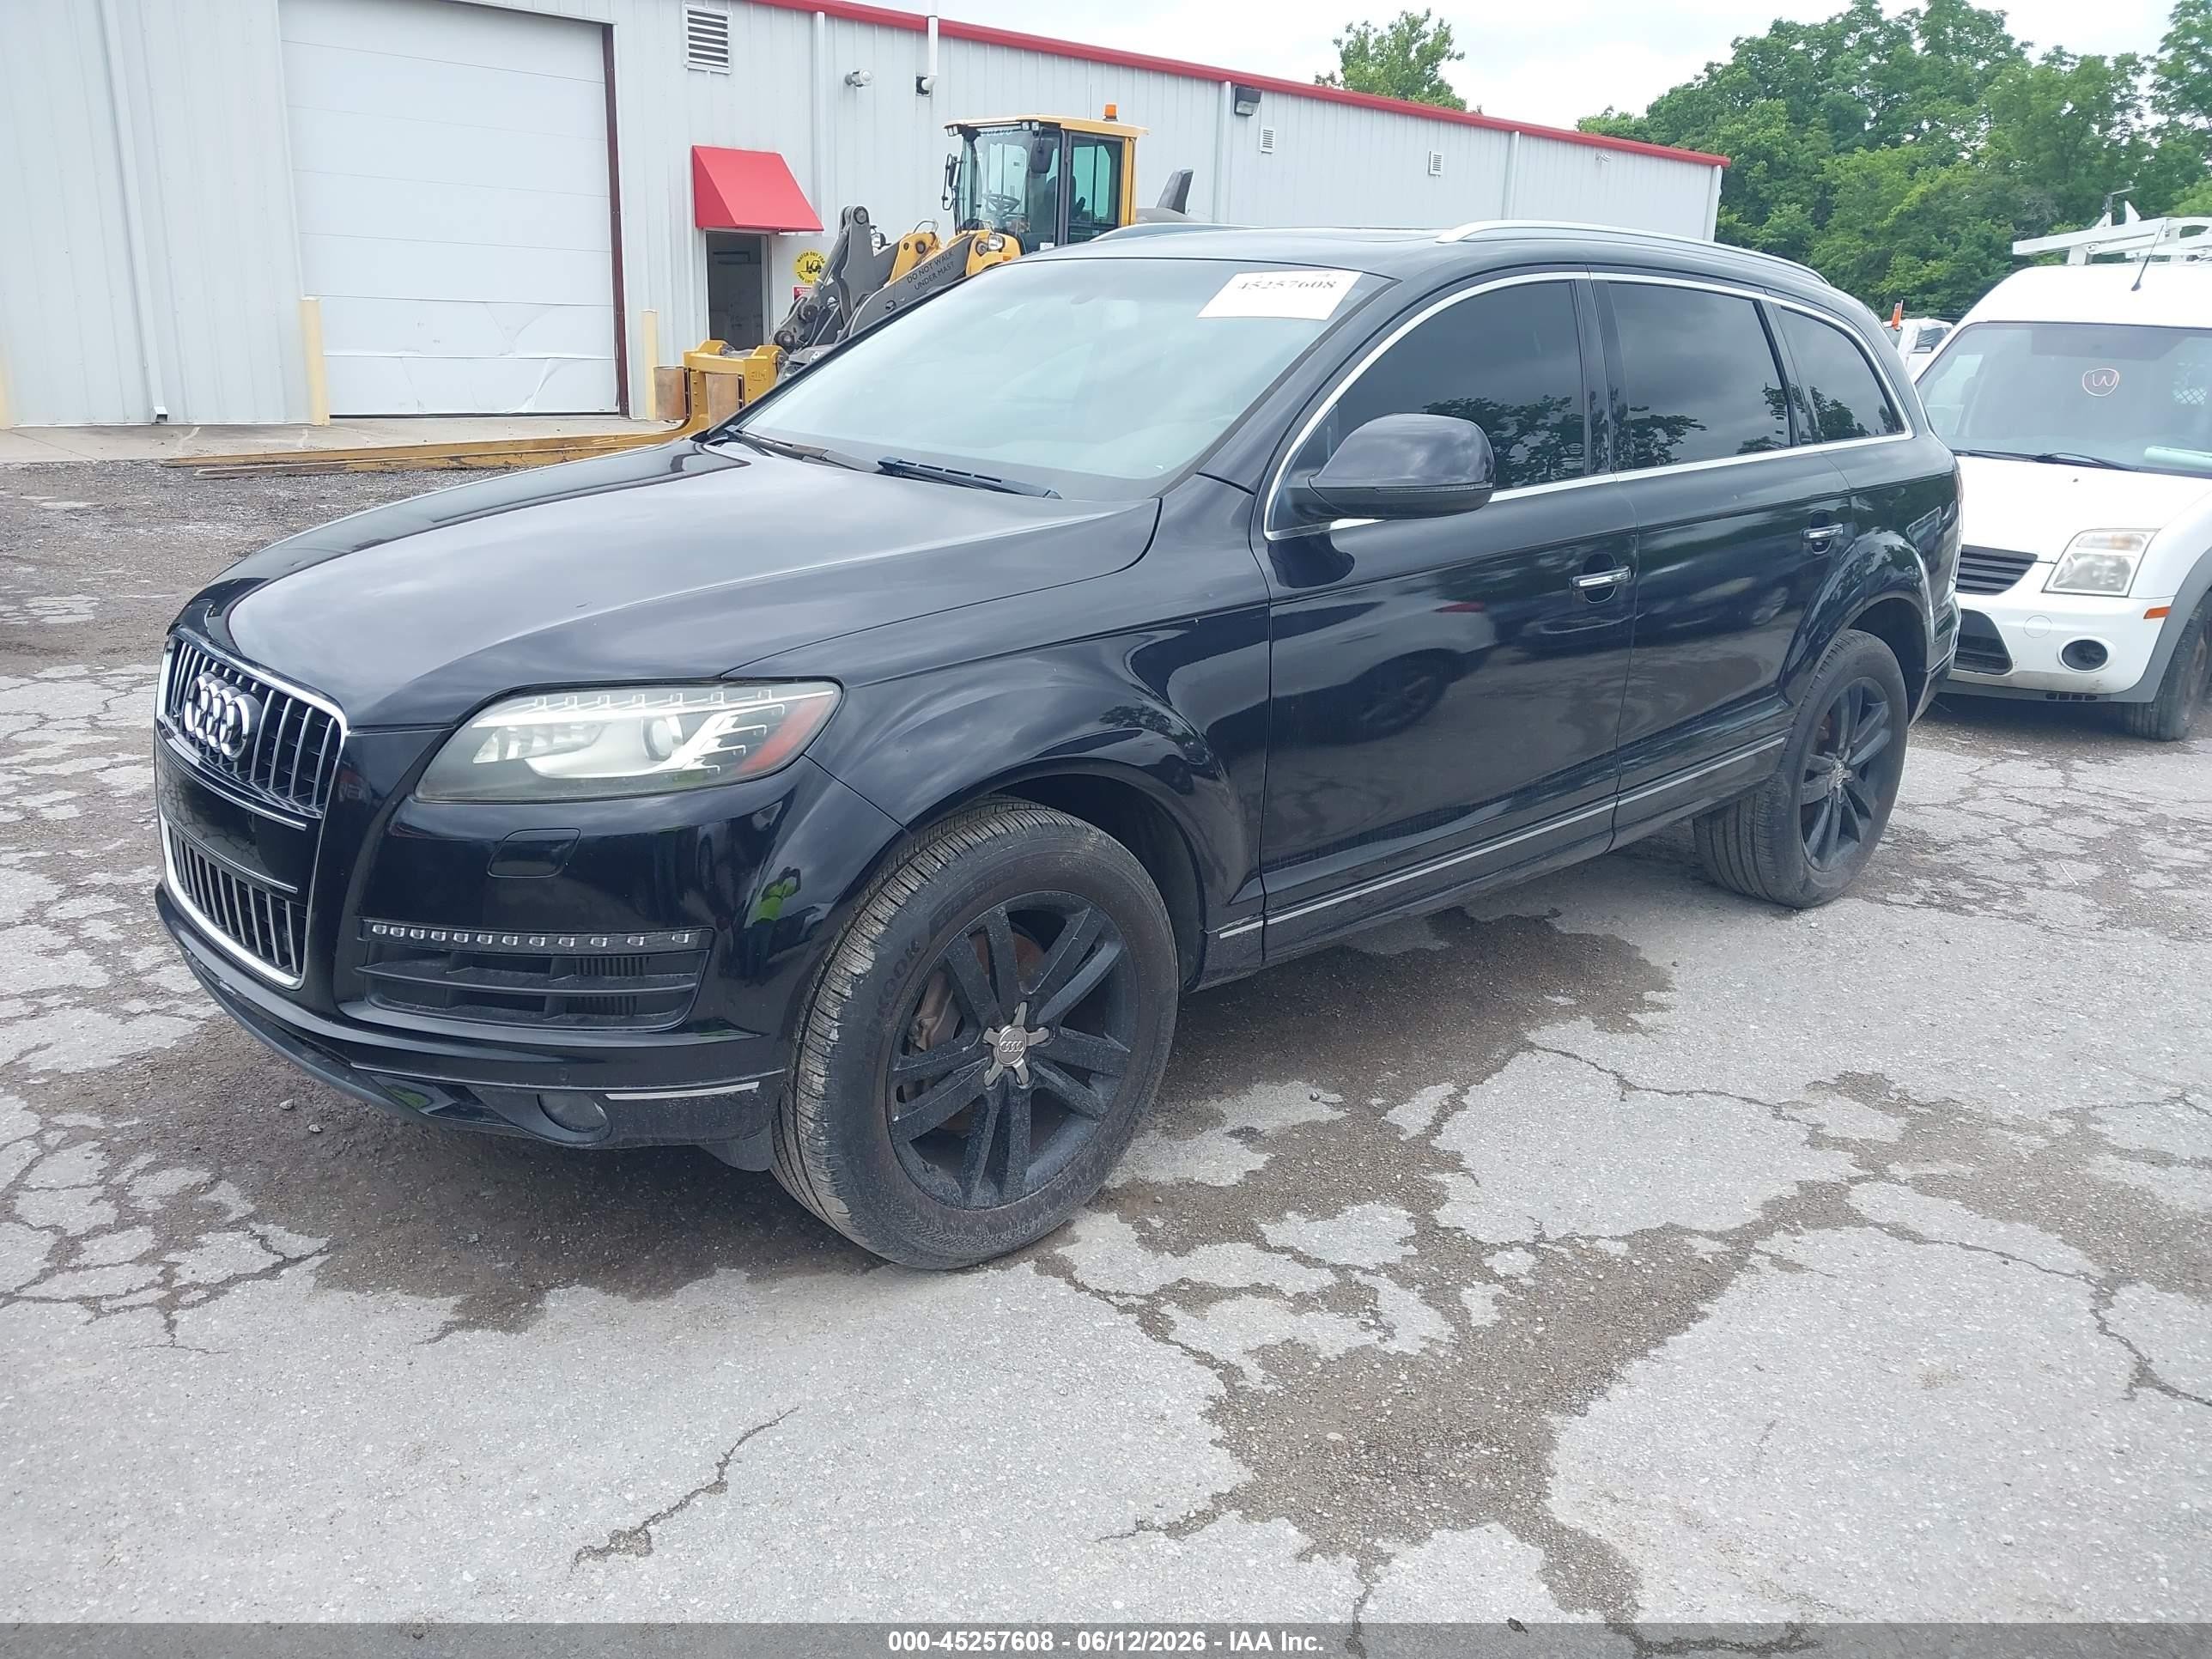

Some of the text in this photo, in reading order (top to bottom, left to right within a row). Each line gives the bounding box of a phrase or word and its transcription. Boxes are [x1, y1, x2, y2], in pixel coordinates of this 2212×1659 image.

[797, 252, 809, 263] WATCH
[907, 250, 954, 283] DO NOT WALK
[914, 261, 954, 289] UNDER MAST
